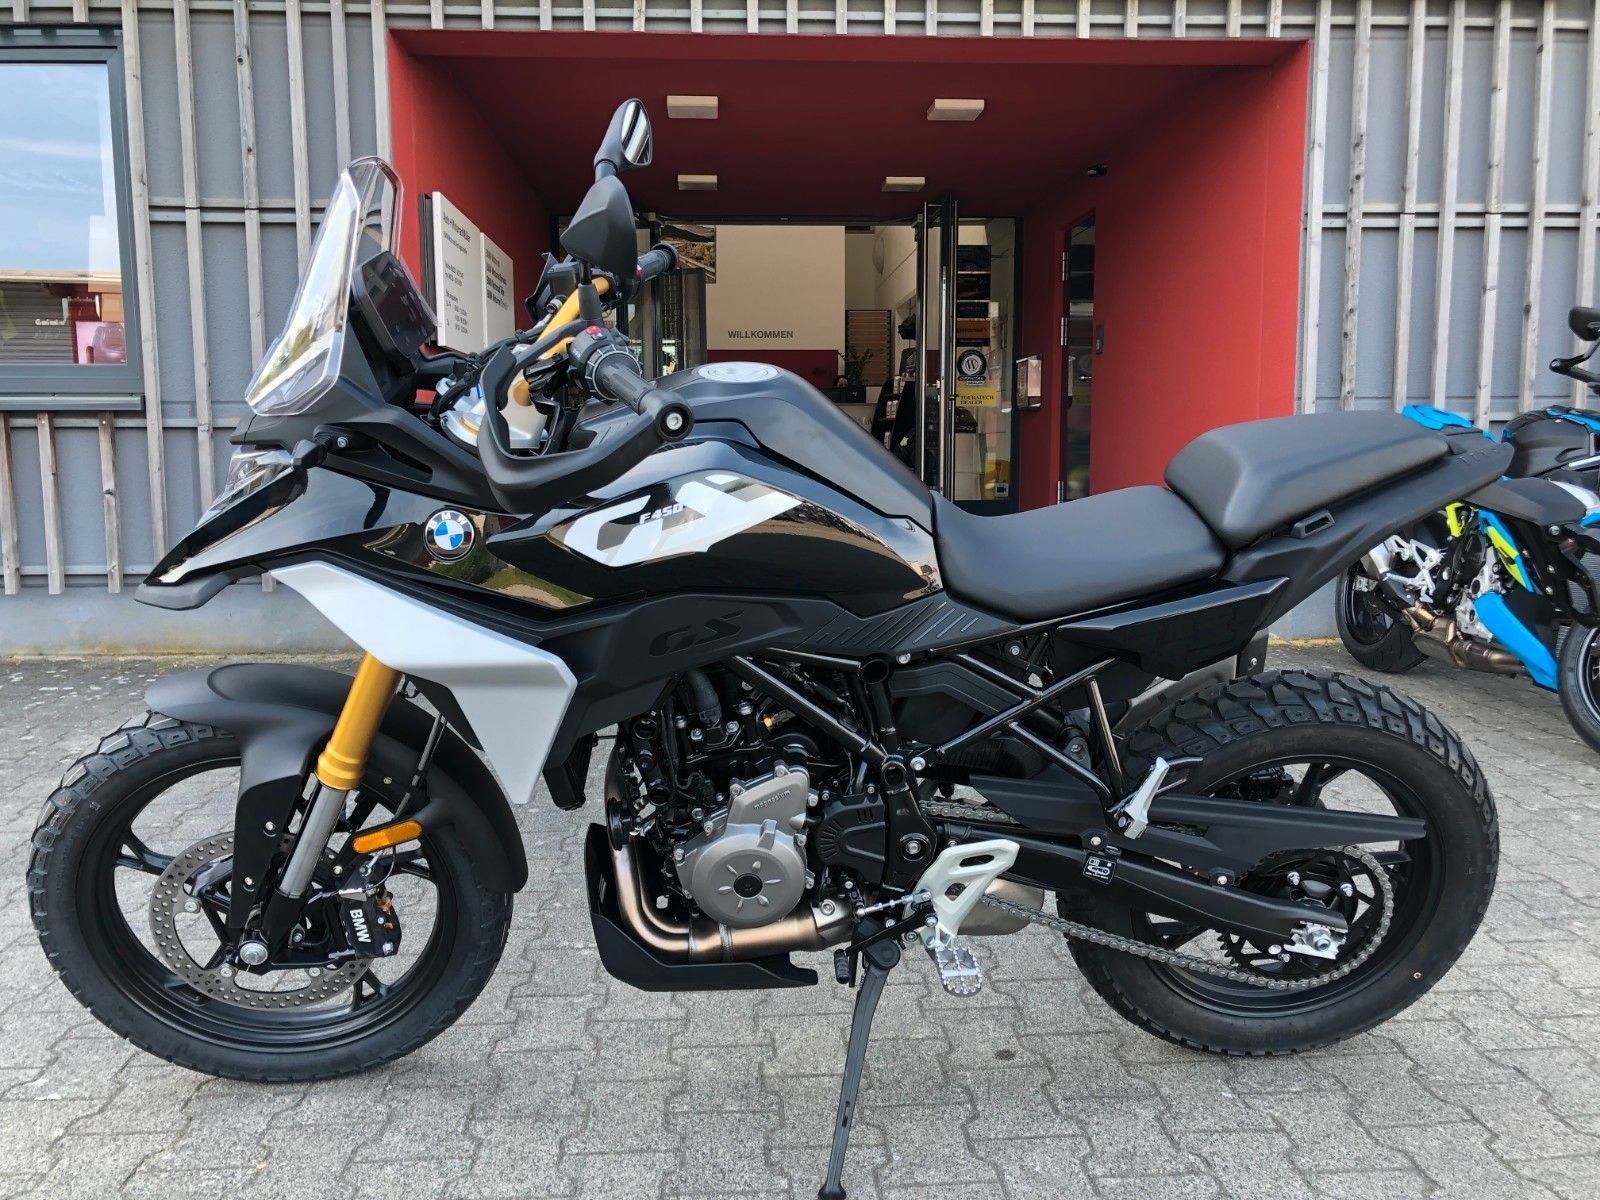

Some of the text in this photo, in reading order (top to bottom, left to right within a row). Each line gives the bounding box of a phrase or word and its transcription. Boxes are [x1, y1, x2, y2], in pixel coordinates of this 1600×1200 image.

[727, 330, 794, 339] WILLKOMMEN
[754, 790, 791, 810] magnesium
[350, 908, 372, 943] BMW
